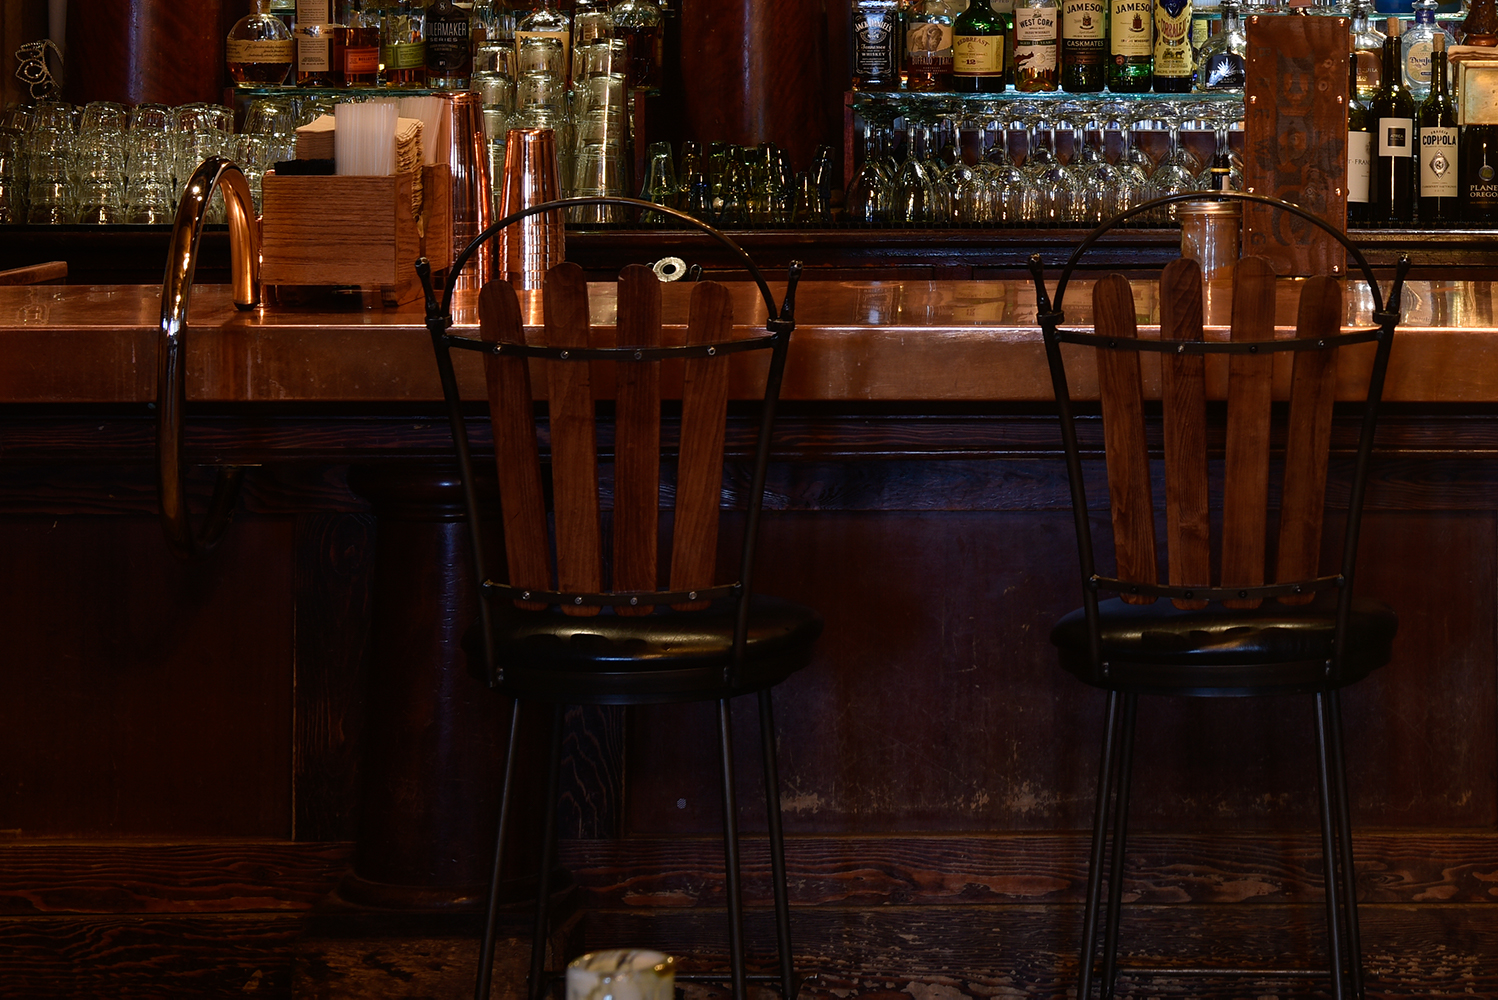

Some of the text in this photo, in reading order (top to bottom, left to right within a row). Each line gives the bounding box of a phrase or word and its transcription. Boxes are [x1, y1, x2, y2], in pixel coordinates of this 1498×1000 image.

[1020, 18, 1053, 28] WEST CORK
[957, 36, 990, 47] REDBREAST
[1422, 135, 1457, 145] COPPOLA
